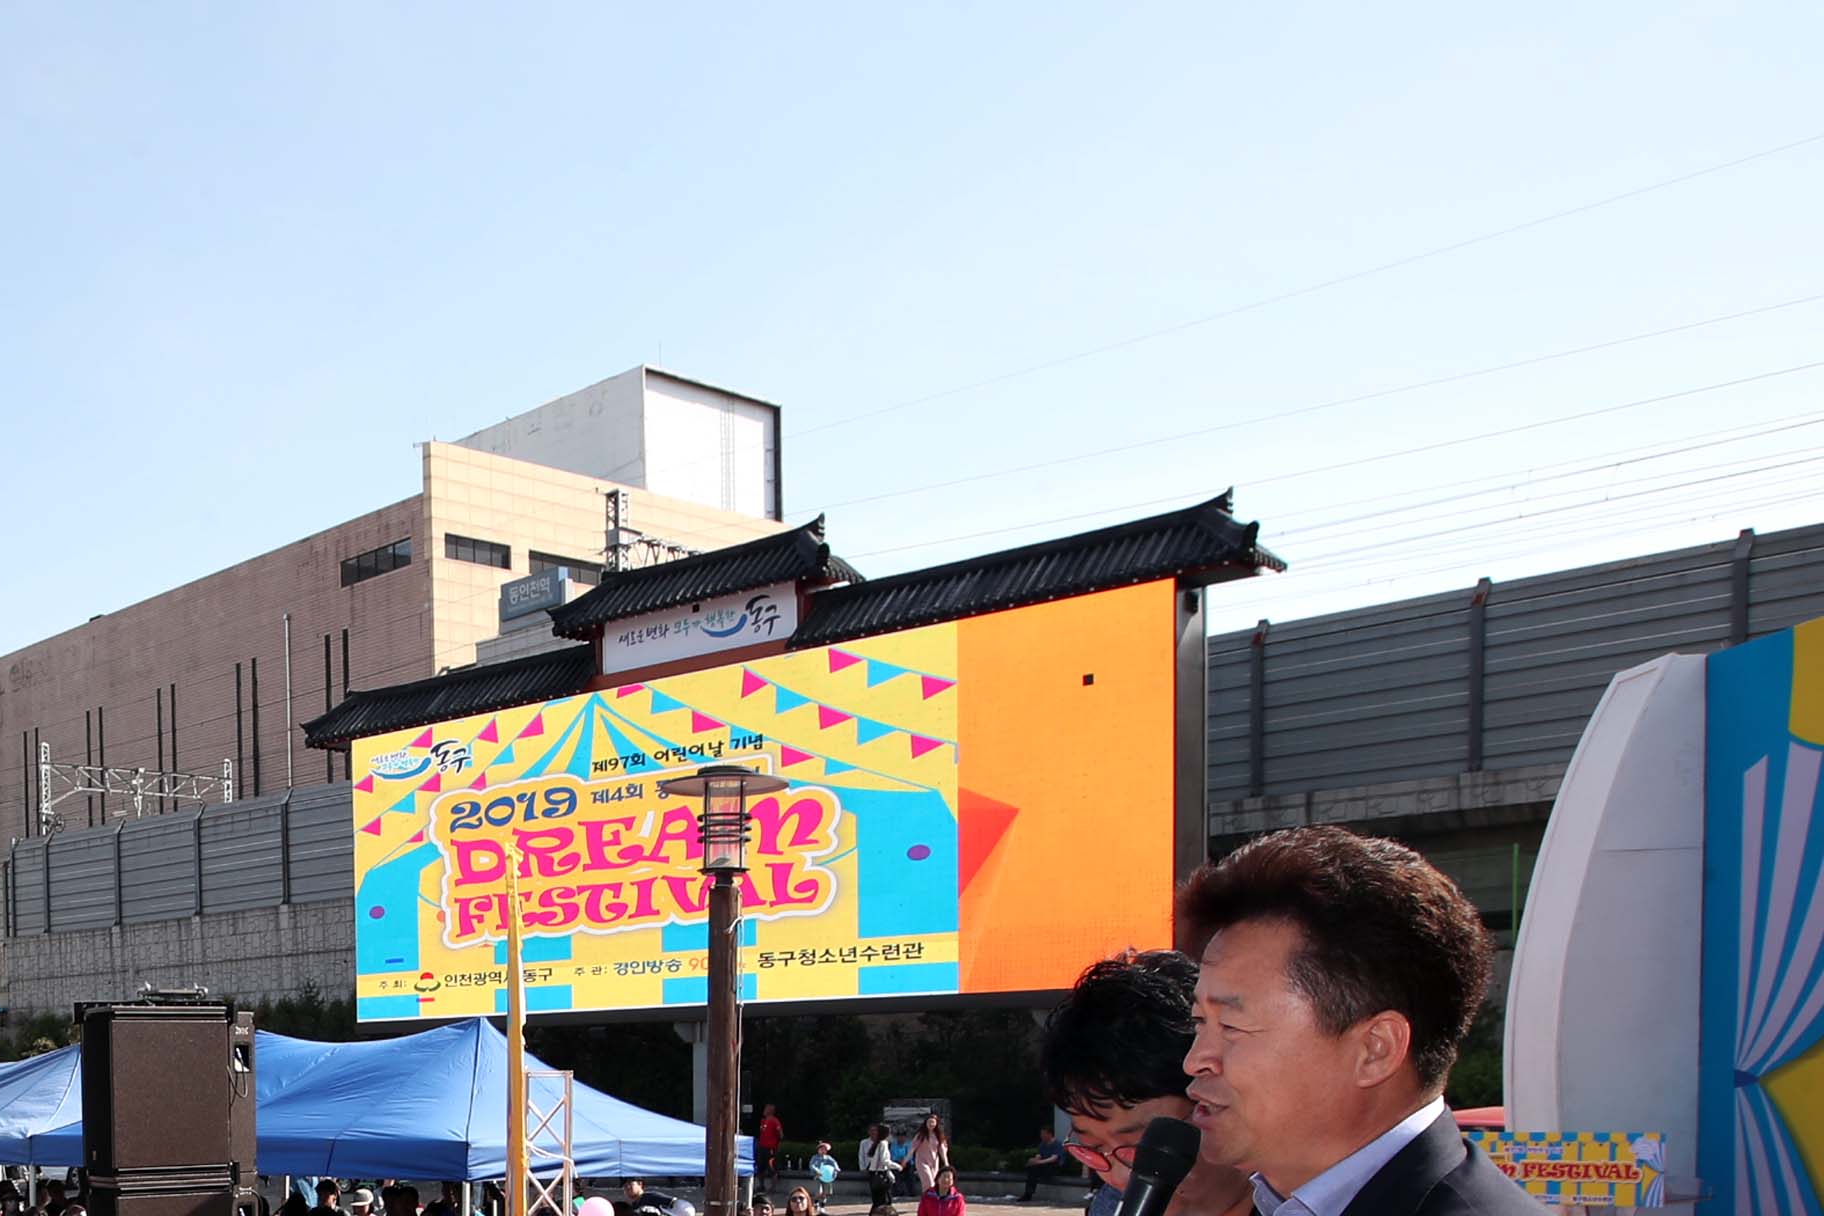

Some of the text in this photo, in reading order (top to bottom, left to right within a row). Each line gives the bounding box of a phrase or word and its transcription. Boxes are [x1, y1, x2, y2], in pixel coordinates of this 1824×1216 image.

[509, 576, 551, 605] 동인천역
[745, 594, 781, 636] 동구
[430, 739, 471, 774] 동구
[592, 753, 646, 773] 제97회
[731, 734, 764, 750] 기념
[591, 783, 644, 804] 제4회
[450, 786, 577, 833] 2019
[450, 797, 824, 886] DREAM
[614, 960, 682, 976] 경인방송
[758, 942, 925, 969] 동구청소년수련관
[444, 972, 509, 988] 인천광역
[1522, 1162, 1641, 1181] FESTIVAL
